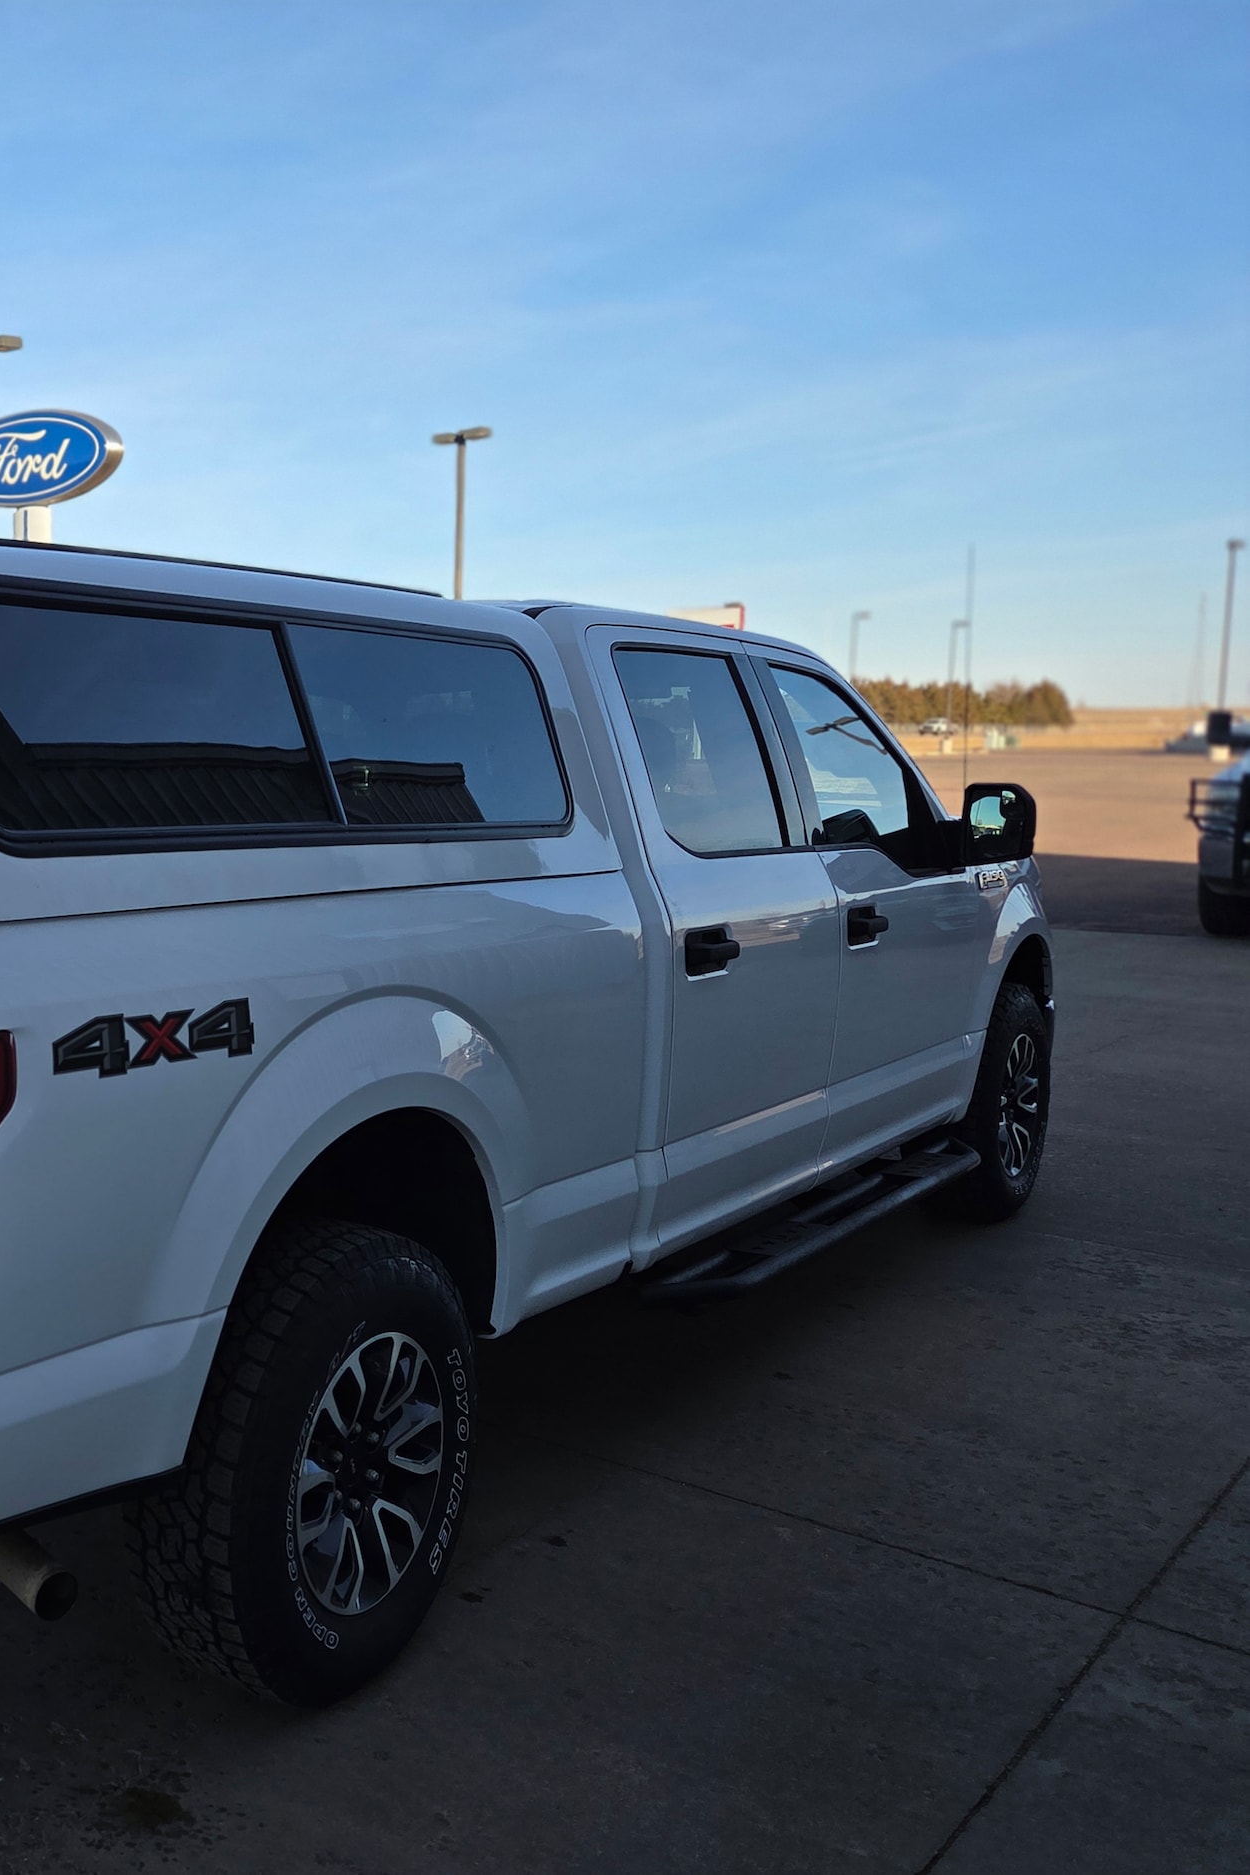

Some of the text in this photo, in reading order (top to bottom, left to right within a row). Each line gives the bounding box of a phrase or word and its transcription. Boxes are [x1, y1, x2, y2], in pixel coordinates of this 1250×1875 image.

[429, 1347, 469, 1576] TOYO TIRES
[295, 1584, 340, 1650] OPEN
